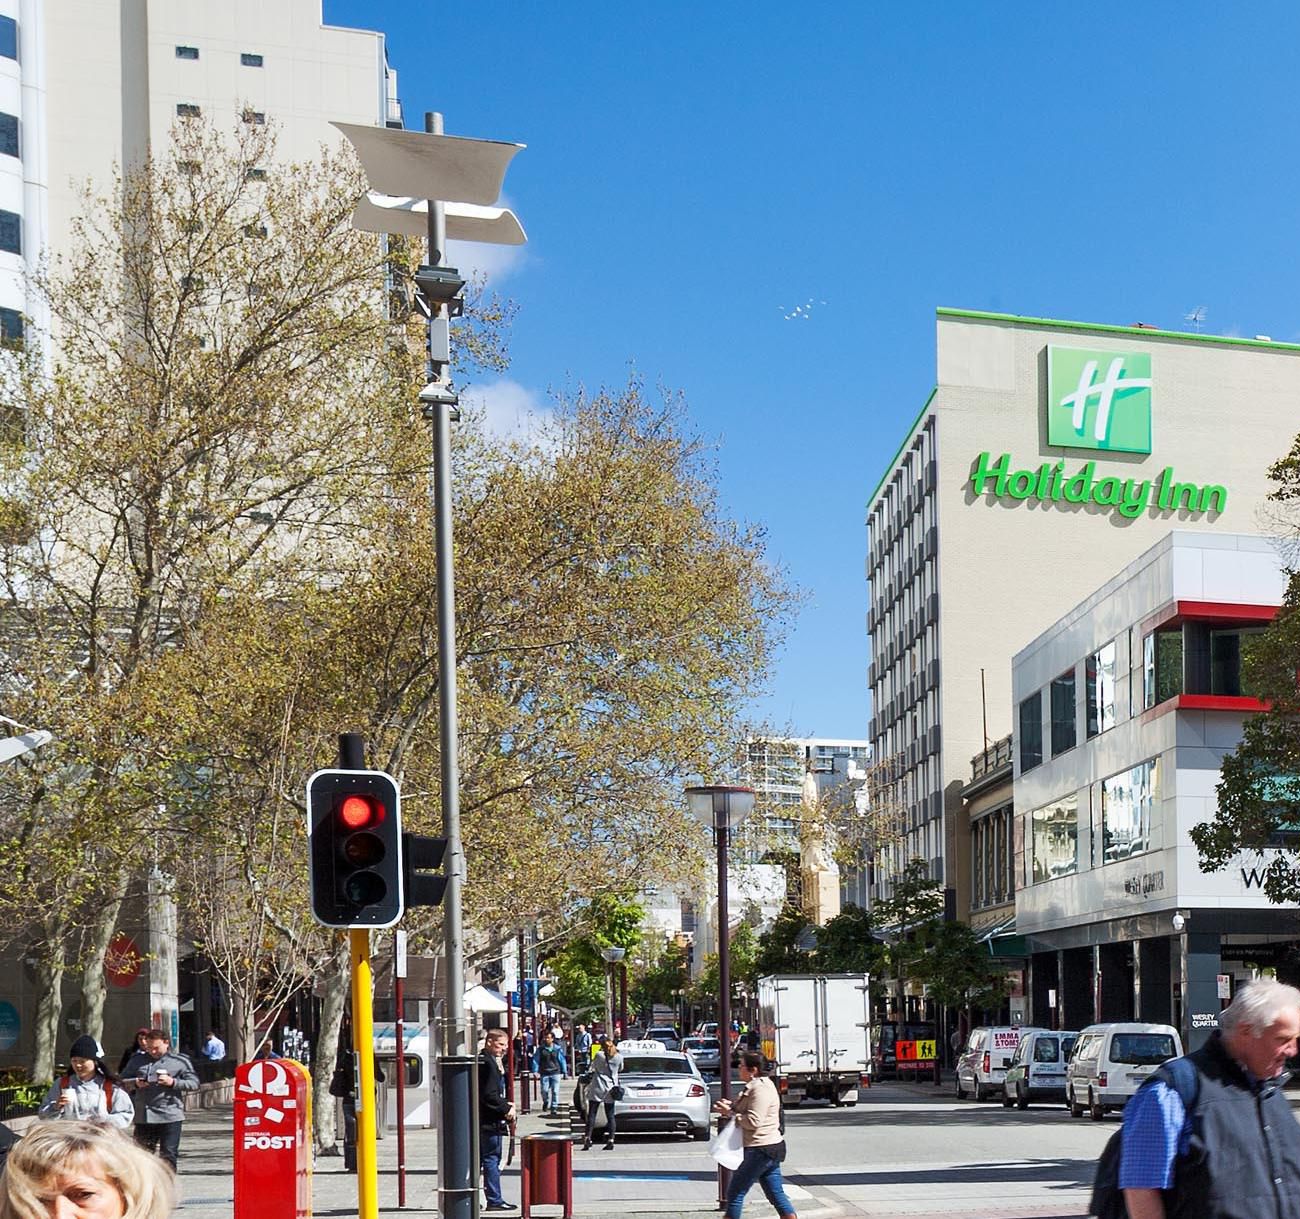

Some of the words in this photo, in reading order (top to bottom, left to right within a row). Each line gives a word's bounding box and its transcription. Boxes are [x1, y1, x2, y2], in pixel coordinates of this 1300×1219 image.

[971, 451, 1151, 518] Holiday
[1158, 466, 1228, 513] Inn
[1192, 1020, 1219, 1029] QUARTER
[243, 1136, 295, 1150] POST
